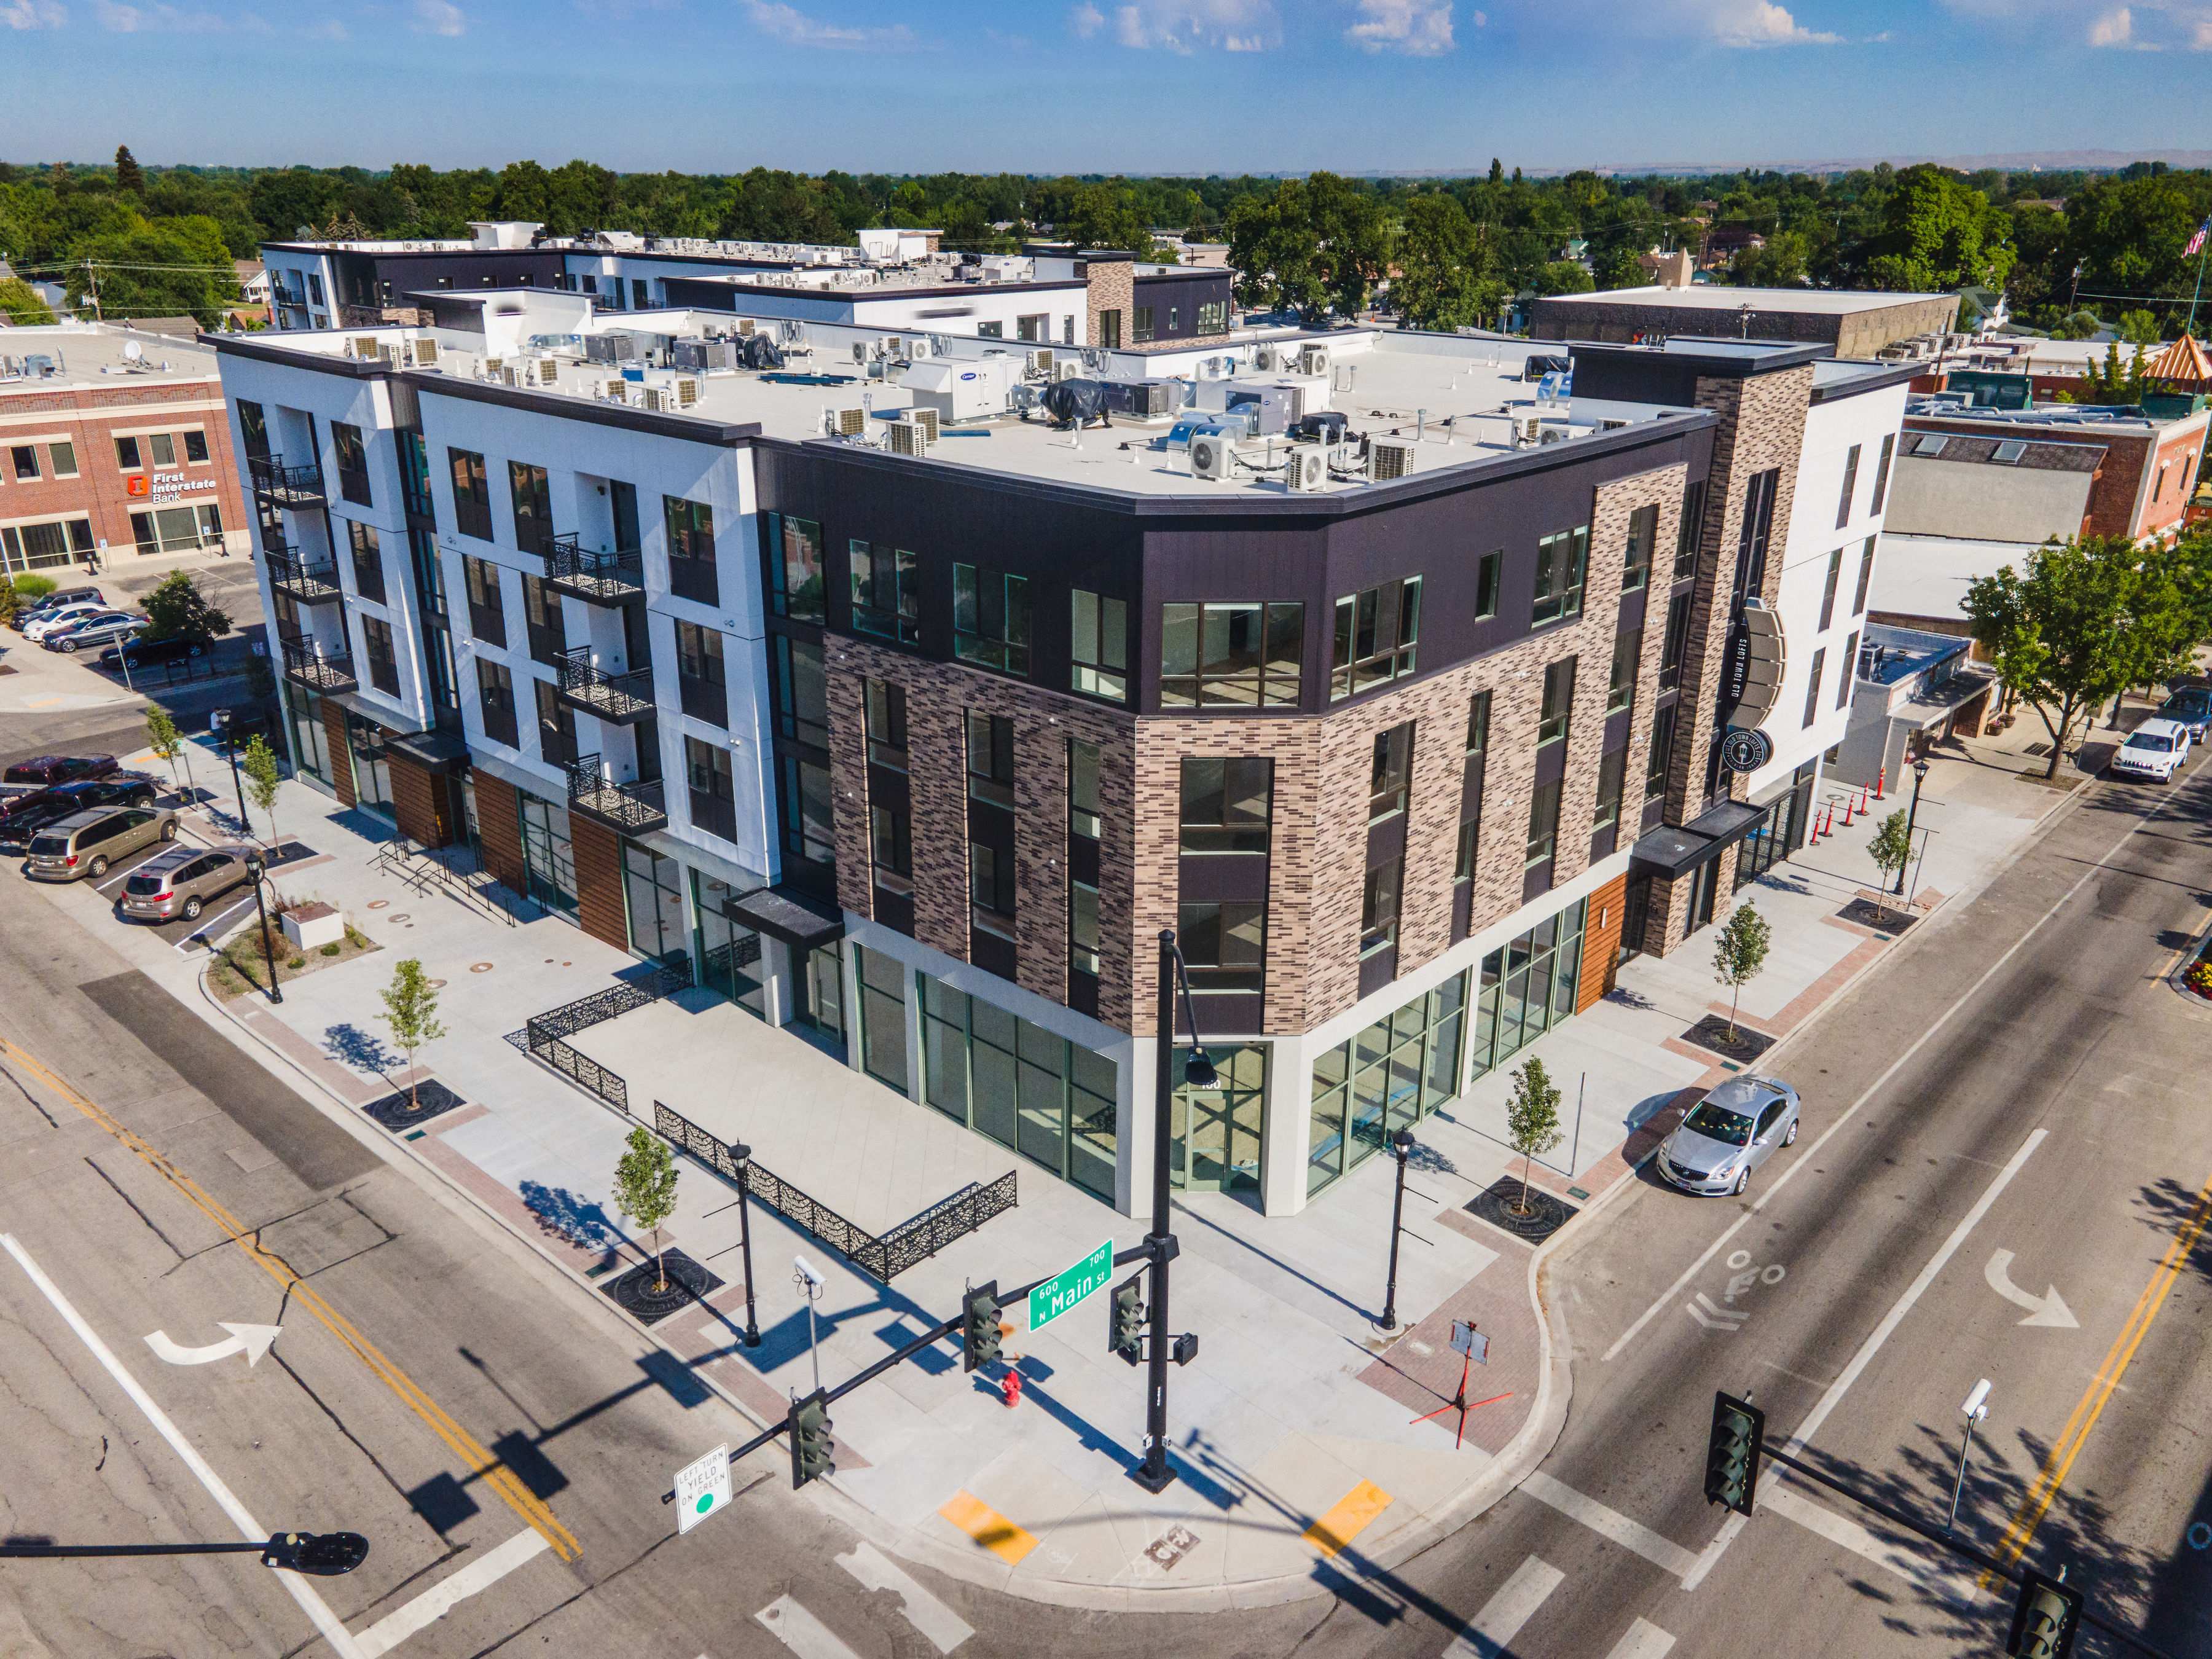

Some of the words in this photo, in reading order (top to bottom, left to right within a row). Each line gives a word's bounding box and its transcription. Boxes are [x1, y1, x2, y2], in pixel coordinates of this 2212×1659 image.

[152, 472, 184, 484] First
[152, 479, 217, 494] Interstate
[152, 492, 181, 504] Bank
[1736, 638, 1747, 660] LOFTS
[1733, 662, 1744, 681] TOWN
[1731, 684, 1740, 697] OLD
[1039, 1281, 1058, 1300] 600
[1089, 1249, 1105, 1268] 700
[1039, 1311, 1046, 1323] N
[1051, 1276, 1092, 1316] Main
[1096, 1271, 1105, 1285] St
[678, 1466, 698, 1484] LEFT
[700, 1450, 724, 1469] TURN
[688, 1466, 717, 1490] YIELD
[681, 1494, 693, 1506] ON
[697, 1472, 726, 1494] GREEN
